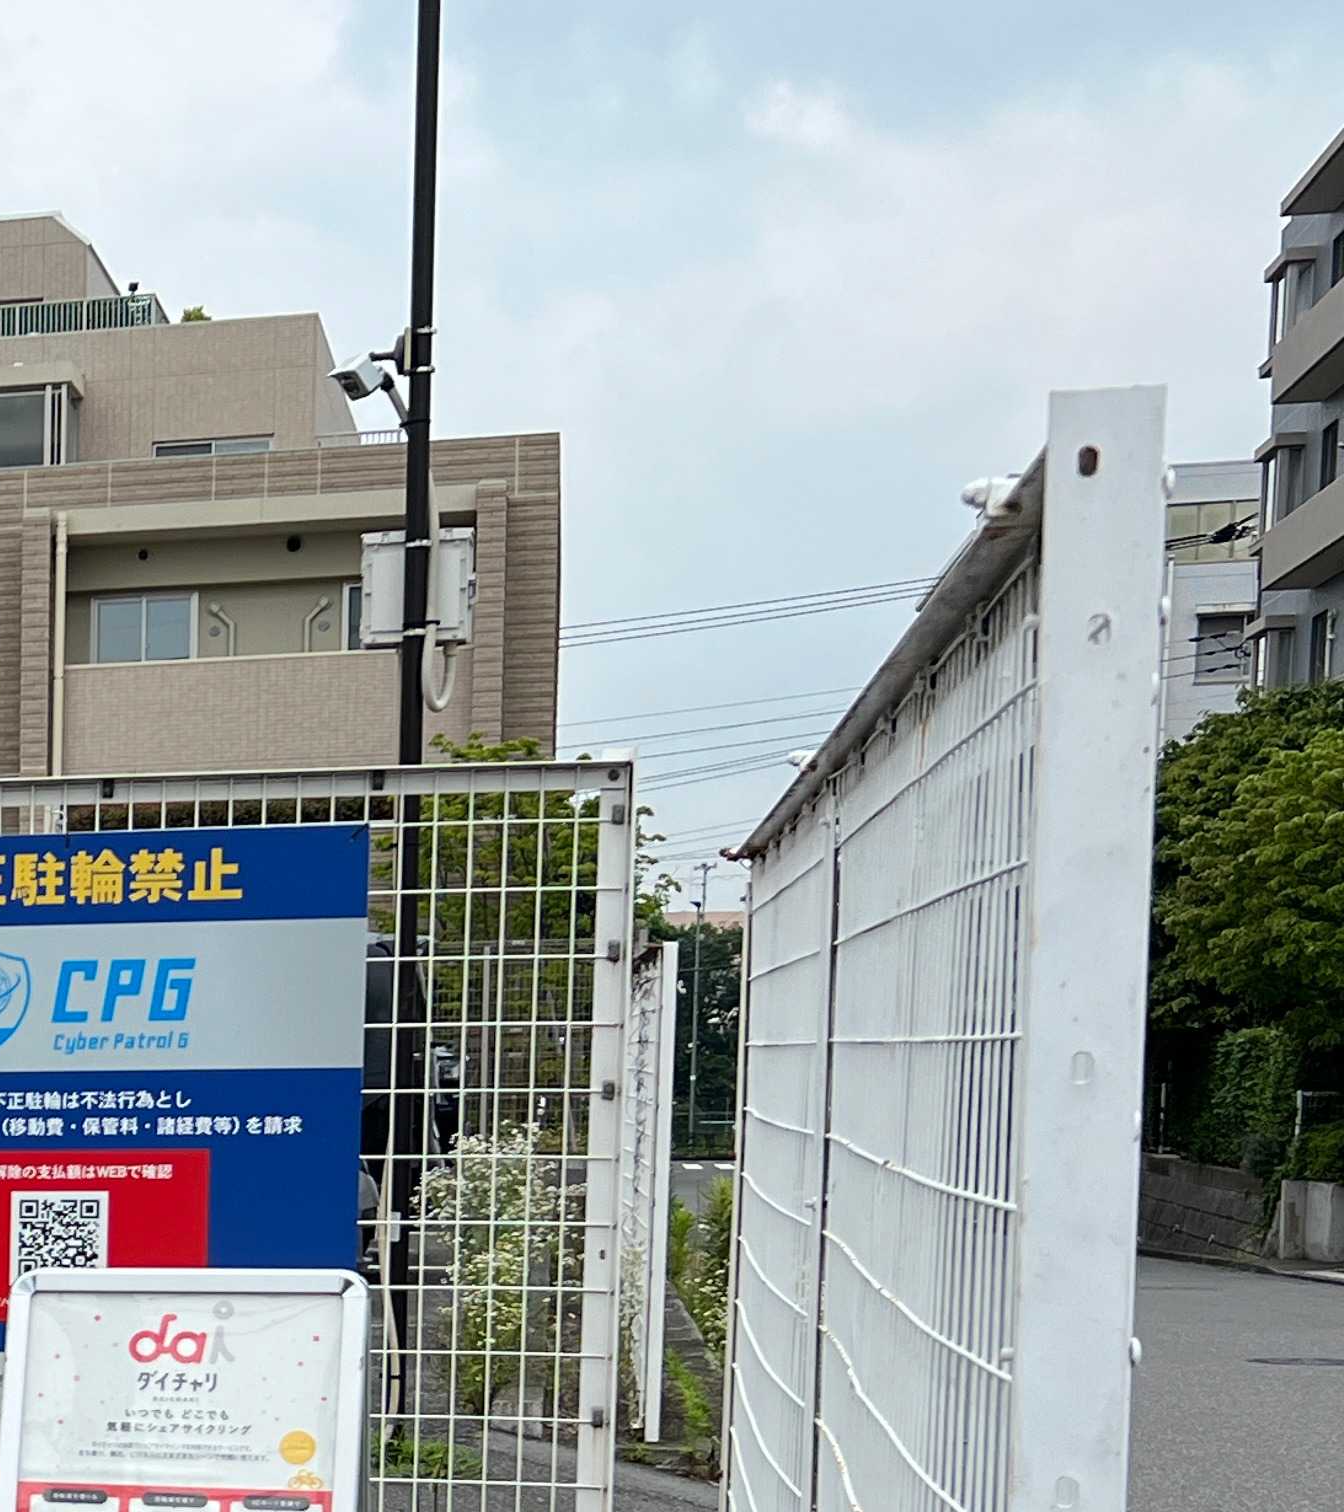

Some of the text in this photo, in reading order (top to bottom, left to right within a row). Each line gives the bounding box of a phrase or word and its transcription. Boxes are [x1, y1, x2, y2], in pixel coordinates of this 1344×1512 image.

[51, 958, 196, 1023] CPG
[53, 1034, 109, 1054] Cyber
[113, 1031, 173, 1050] Patrol
[137, 1371, 218, 1392] ダイチャリ
[124, 1409, 229, 1421] いつでも どこでも
[106, 1421, 252, 1436] 気軽にシェアサイクリング
